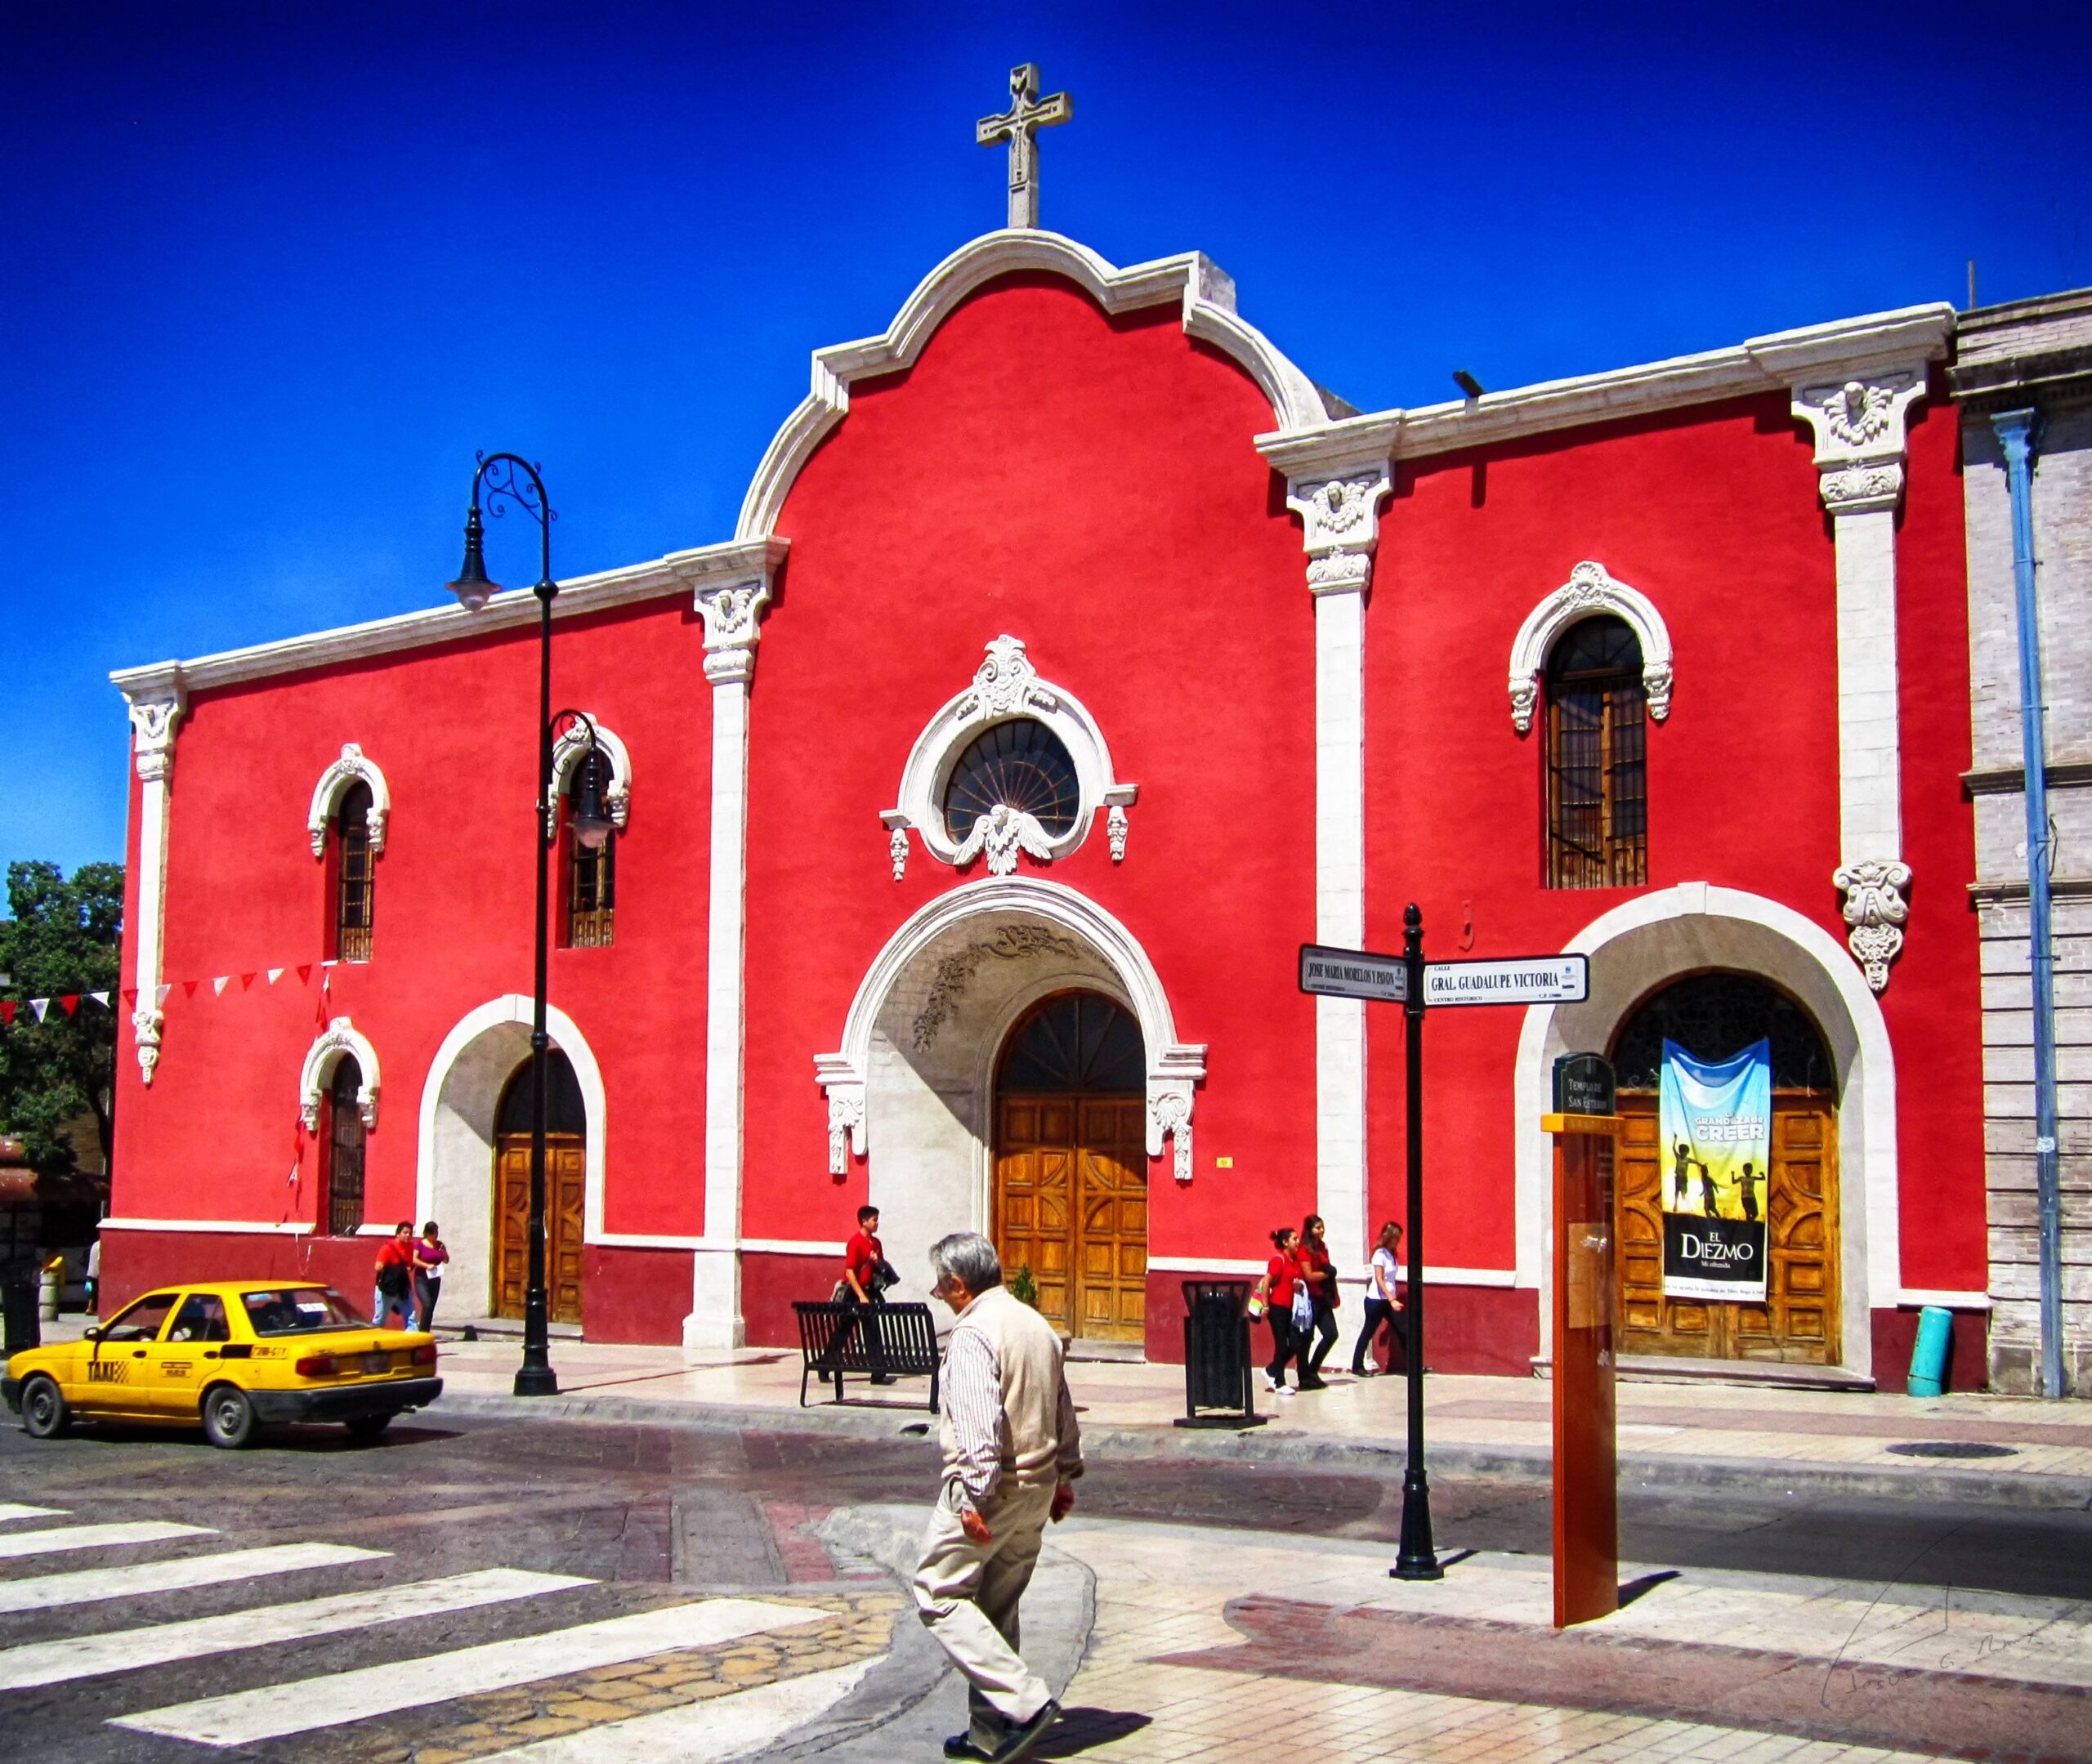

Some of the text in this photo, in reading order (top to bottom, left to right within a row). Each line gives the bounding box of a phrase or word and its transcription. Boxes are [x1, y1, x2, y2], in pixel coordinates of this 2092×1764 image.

[1432, 972, 1558, 991] GRAL. GUADALUPE VICTORIA
[1695, 1123, 1764, 1141] CREER
[1710, 1231, 1721, 1242] EL
[1680, 1233, 1754, 1260] DIEZMO
[87, 1361, 114, 1382] TAXI
